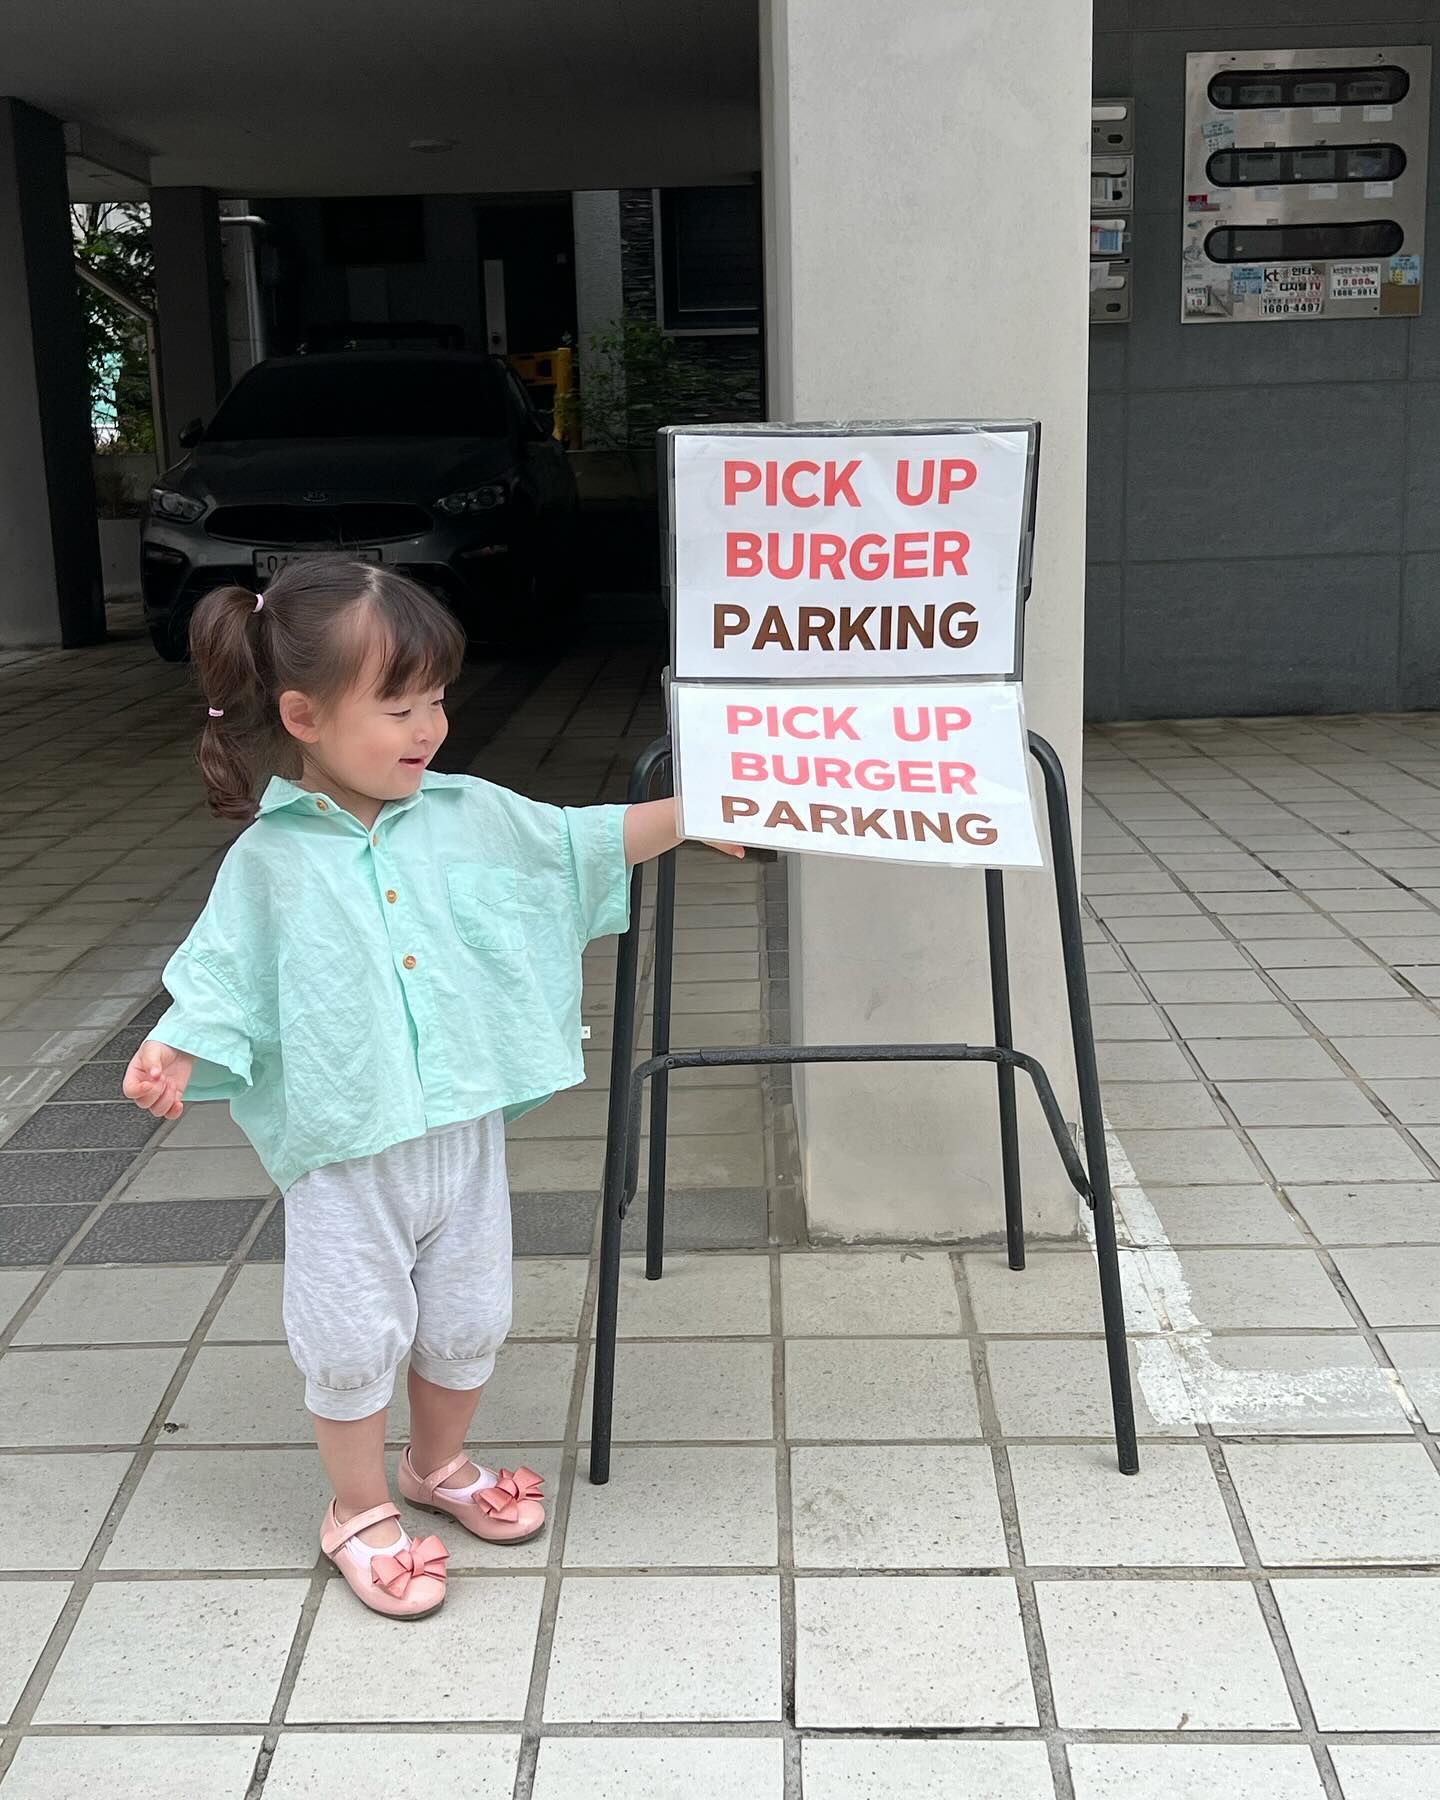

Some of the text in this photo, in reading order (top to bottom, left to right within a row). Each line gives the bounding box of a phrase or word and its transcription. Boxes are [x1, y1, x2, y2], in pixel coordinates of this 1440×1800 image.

[1263, 269, 1280, 282] kt
[723, 458, 978, 508] PICK UP
[726, 530, 971, 581] BURGER
[713, 602, 979, 651] PARKING
[726, 705, 972, 742] PICK UP
[730, 751, 978, 795] BURGER
[721, 795, 999, 847] PARKING
